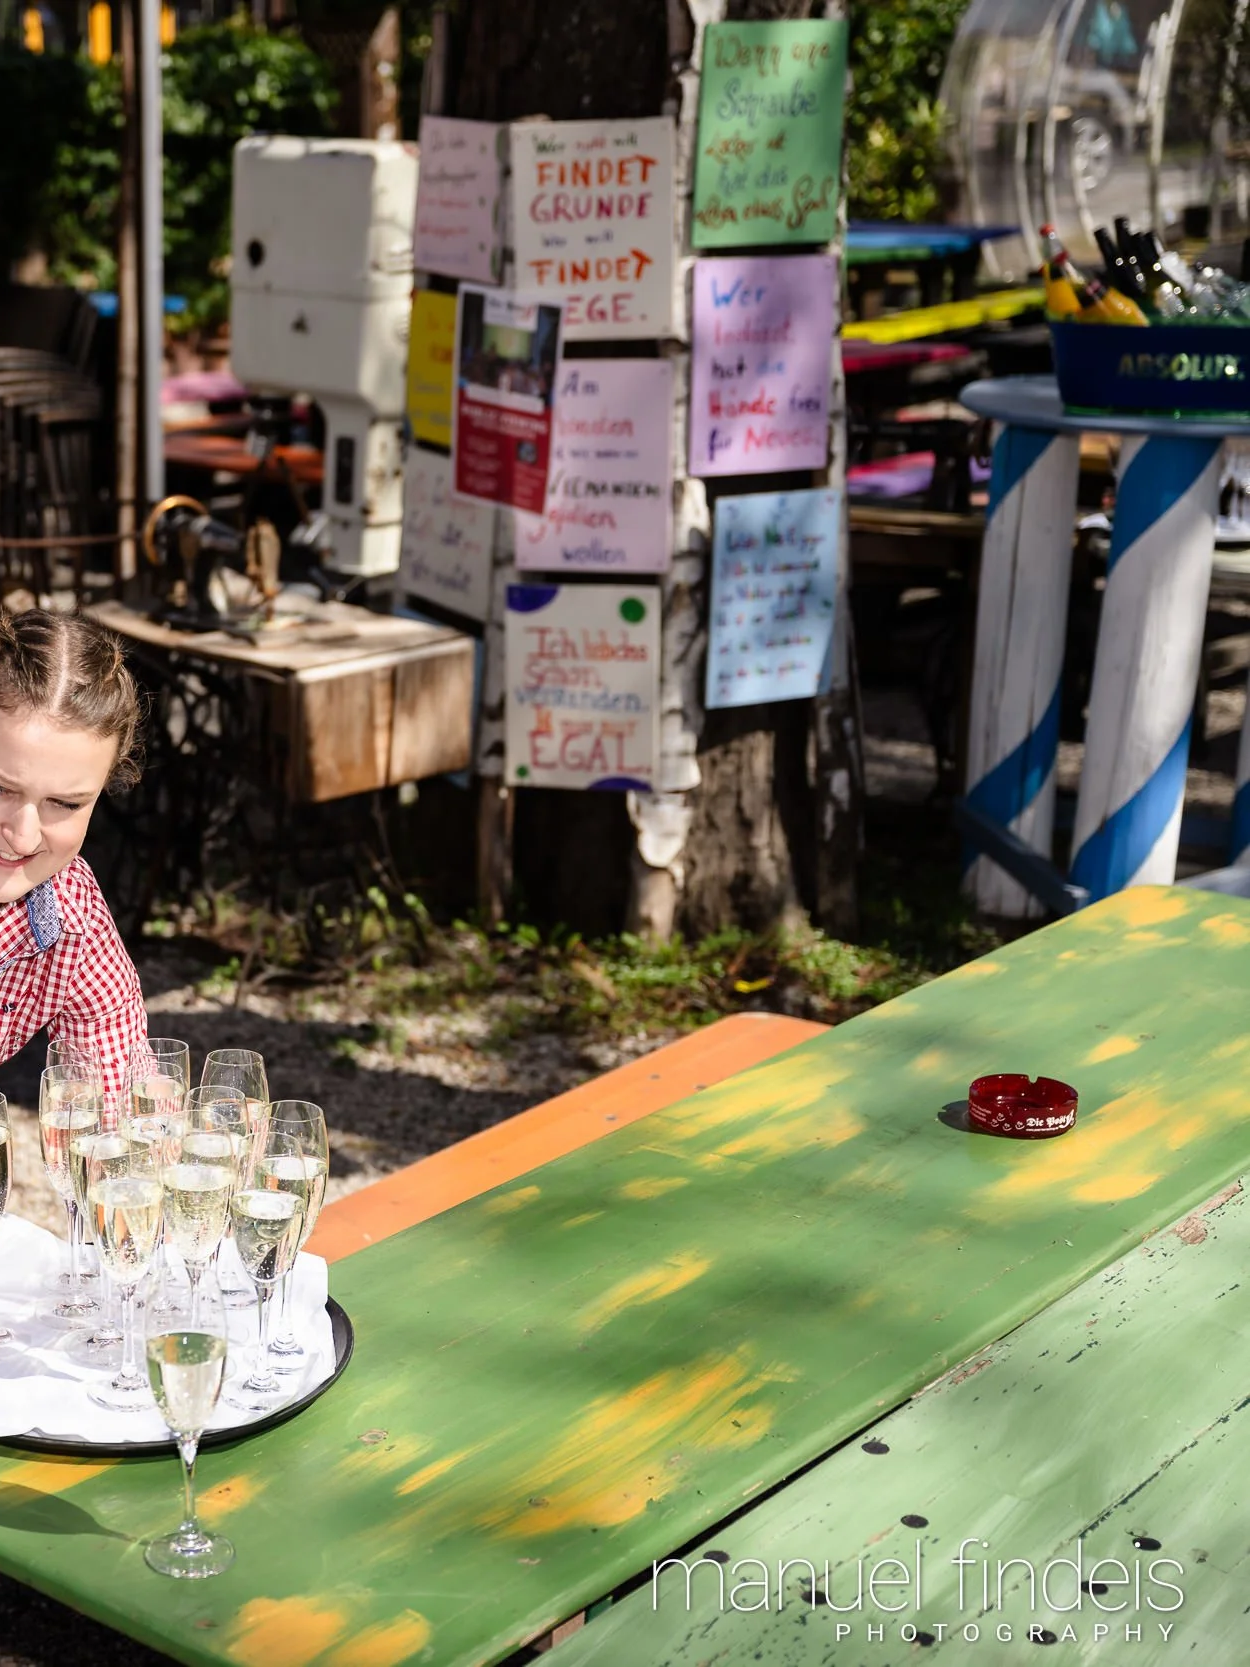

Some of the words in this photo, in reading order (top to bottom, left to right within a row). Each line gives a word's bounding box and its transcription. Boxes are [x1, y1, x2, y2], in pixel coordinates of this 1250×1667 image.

[536, 153, 659, 188] FINDET
[528, 248, 653, 286] FINDET
[562, 292, 648, 325] EGE.
[712, 277, 765, 308] Wer
[712, 354, 747, 379] hat
[709, 386, 777, 420] Hände
[524, 627, 579, 661] Ich
[1026, 1117, 1044, 1127] Die
